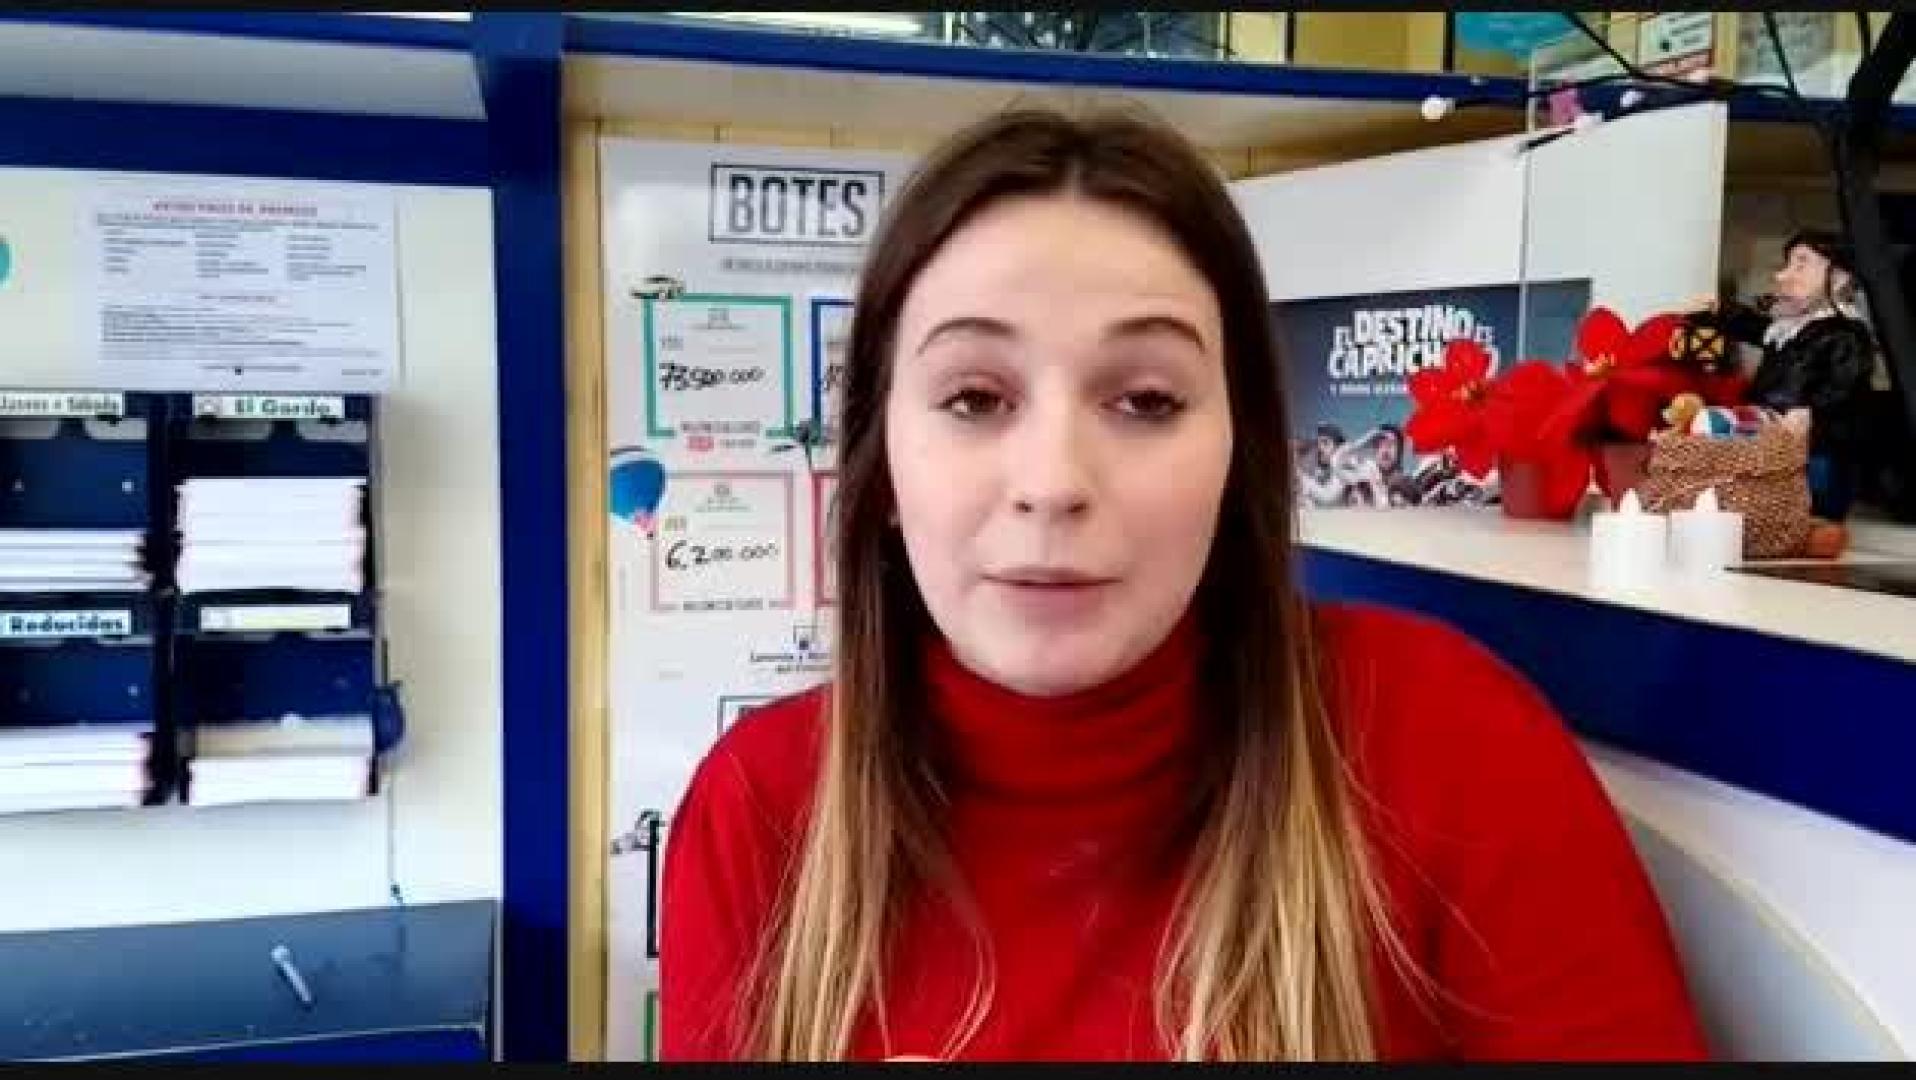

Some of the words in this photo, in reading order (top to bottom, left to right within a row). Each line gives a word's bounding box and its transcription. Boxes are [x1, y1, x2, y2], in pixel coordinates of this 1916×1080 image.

[728, 173, 867, 238] BOTES
[1354, 304, 1475, 344] DESTINO
[1328, 344, 1499, 380] CAPRICH
[261, 398, 331, 415] Gordo
[10, 614, 124, 632] Reducidas
